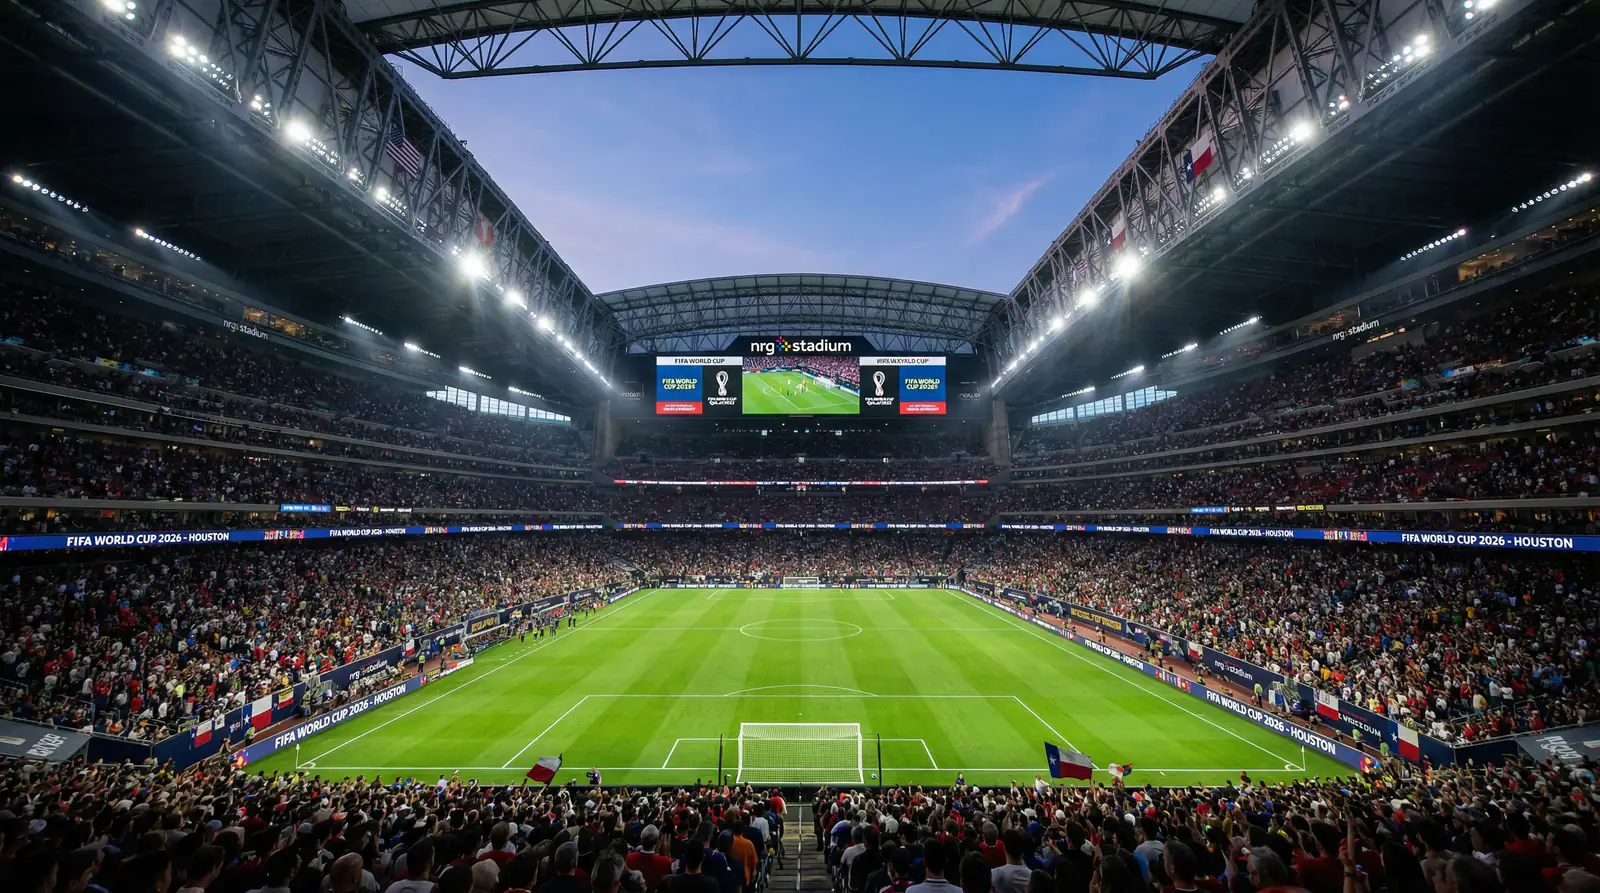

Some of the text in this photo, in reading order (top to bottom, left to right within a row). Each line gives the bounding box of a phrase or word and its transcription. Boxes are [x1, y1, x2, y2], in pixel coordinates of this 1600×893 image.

[239, 324, 269, 340] stadium
[750, 339, 852, 355] nrg stadium
[66, 536, 92, 546] FIFA
[94, 535, 135, 545] WORLD
[136, 534, 157, 544] CUP
[158, 533, 182, 543] 2026
[188, 532, 229, 542] HOUSTON
[1401, 533, 1420, 543] FIFA
[1420, 534, 1455, 544] WORLD
[1456, 535, 1477, 545] CUP
[1479, 535, 1506, 546] 2026
[1513, 536, 1573, 549] HOUSTON
[274, 732, 296, 749] FIFA
[297, 716, 331, 738] WORLD
[331, 708, 349, 723] CUP
[349, 700, 369, 716] 2026
[373, 684, 406, 706] HOUSTON
[1206, 690, 1221, 704] FIFA
[1220, 694, 1247, 715] WORLD
[1247, 708, 1263, 722] CUP
[1263, 714, 1285, 733] 2026
[1290, 726, 1336, 755] HOUSTON
